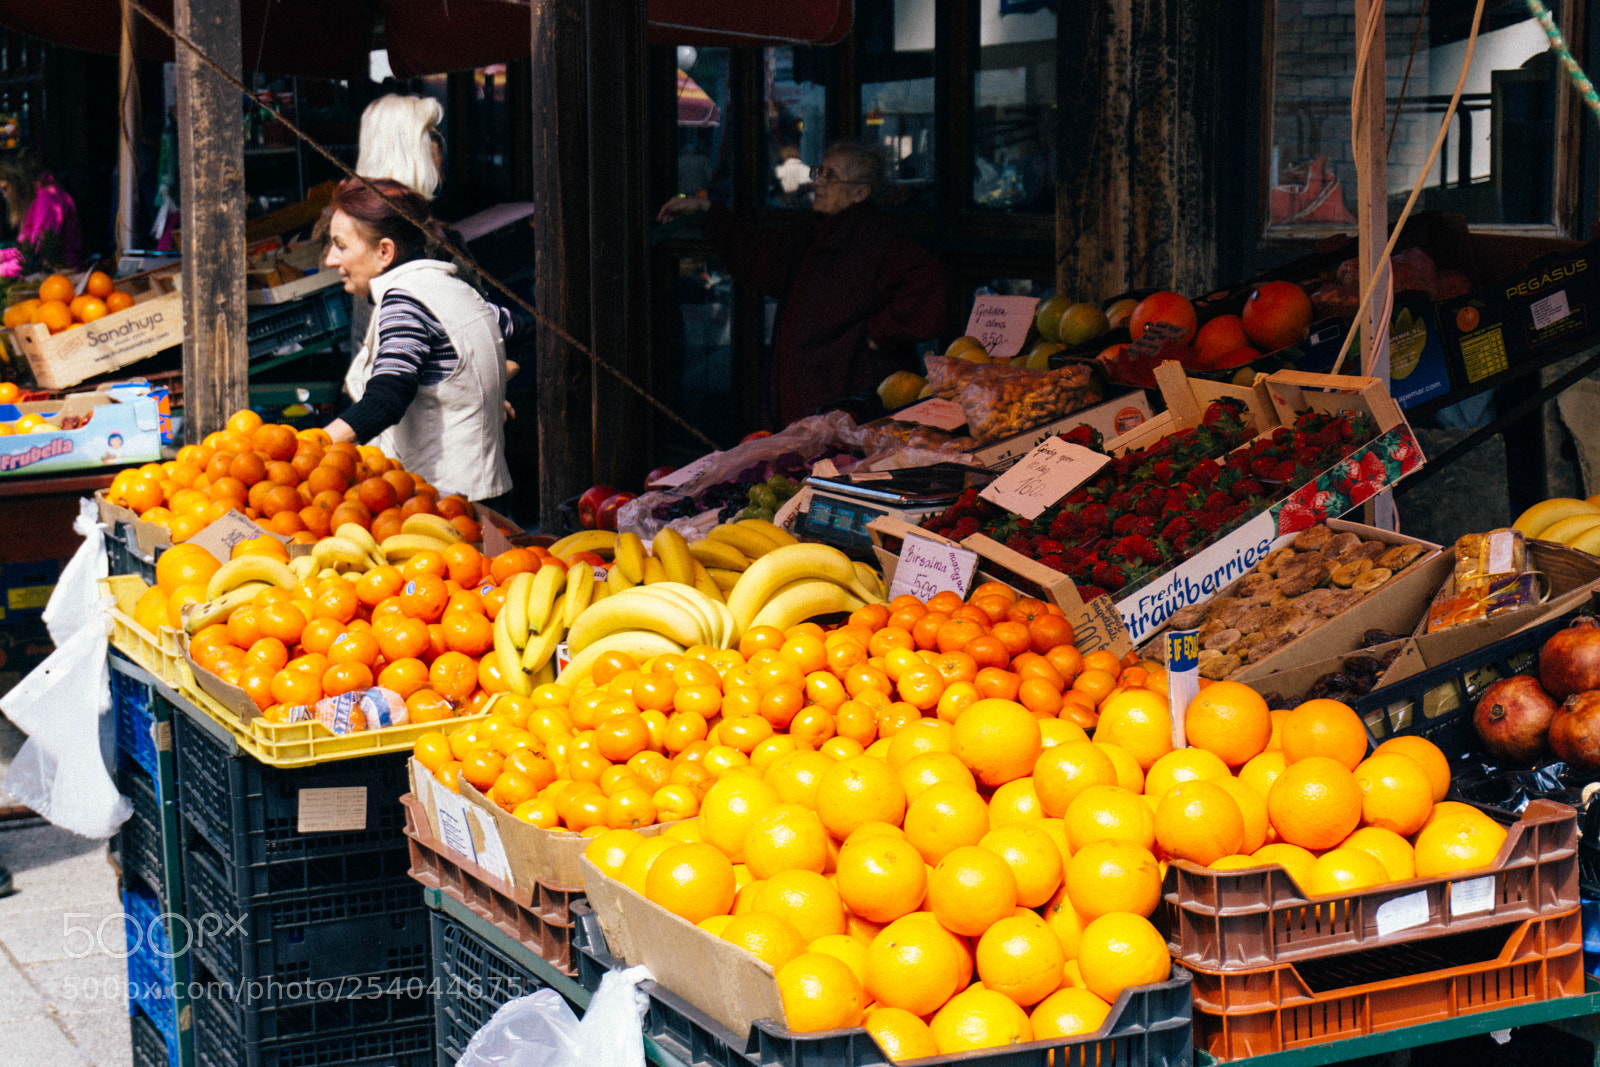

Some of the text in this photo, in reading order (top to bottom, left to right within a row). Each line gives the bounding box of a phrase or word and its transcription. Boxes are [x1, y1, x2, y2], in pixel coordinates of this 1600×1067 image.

[1505, 259, 1588, 300] PEGASUS
[86, 312, 163, 347] Sanahuja
[0, 437, 74, 471] Frubella
[911, 573, 937, 600] 500
[1139, 571, 1183, 614] Fresh
